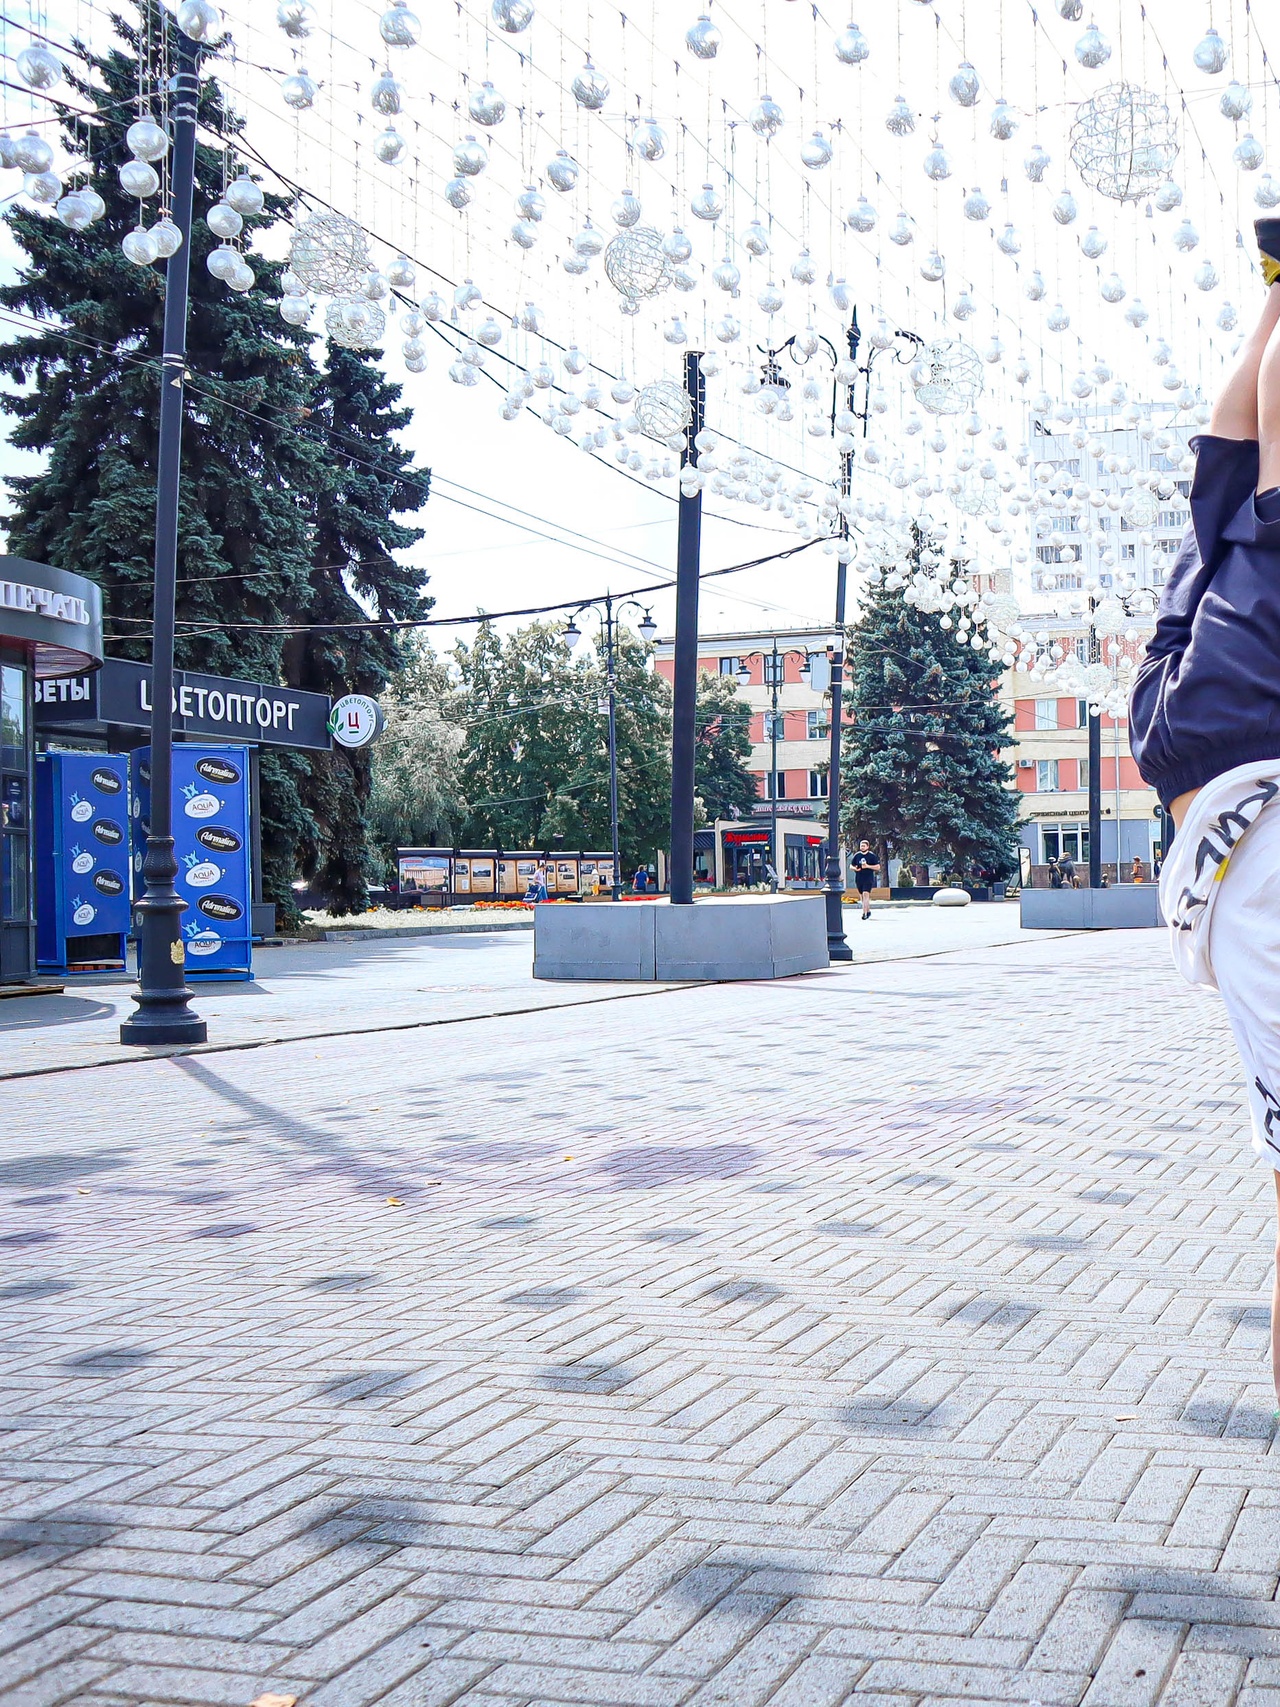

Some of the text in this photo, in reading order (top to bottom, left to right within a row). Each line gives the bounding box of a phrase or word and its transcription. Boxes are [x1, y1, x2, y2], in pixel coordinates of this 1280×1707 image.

[0, 580, 90, 626] ПЕЧАТЬ
[348, 712, 360, 729] Ц
[192, 801, 214, 811] AQUA
[193, 870, 215, 879] AQUA
